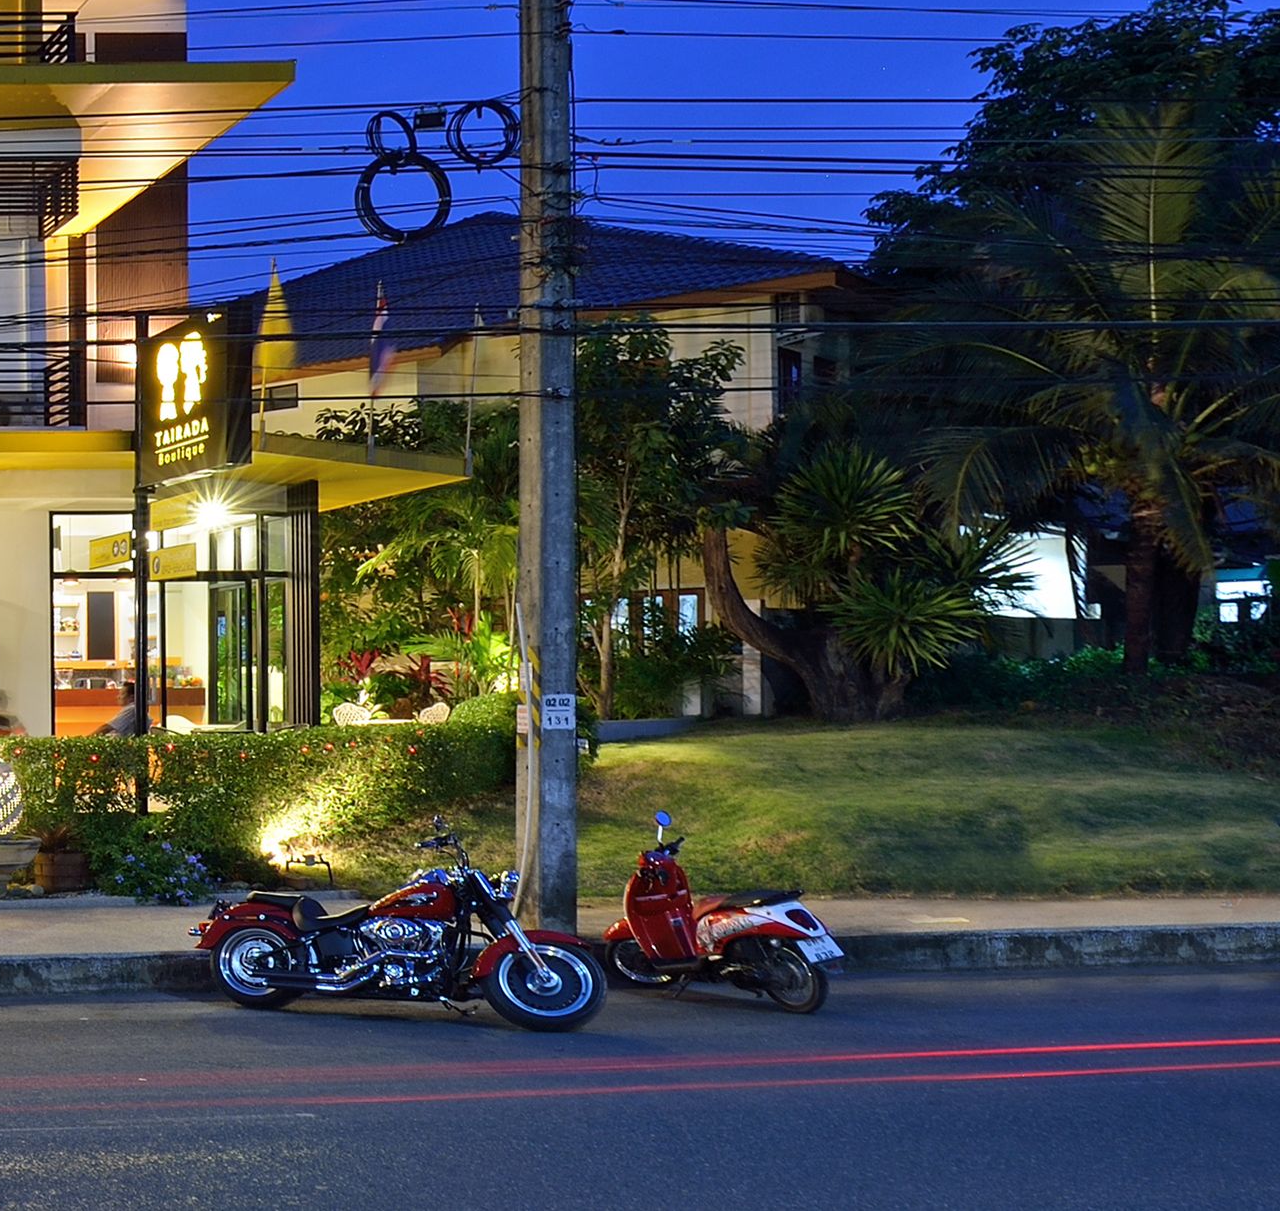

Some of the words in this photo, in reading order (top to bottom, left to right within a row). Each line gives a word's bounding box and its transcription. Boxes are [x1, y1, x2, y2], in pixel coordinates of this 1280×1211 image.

[154, 416, 209, 448] TAIRADA
[158, 442, 205, 466] Boutique
[545, 697, 557, 707] 02
[558, 697, 570, 707] 02
